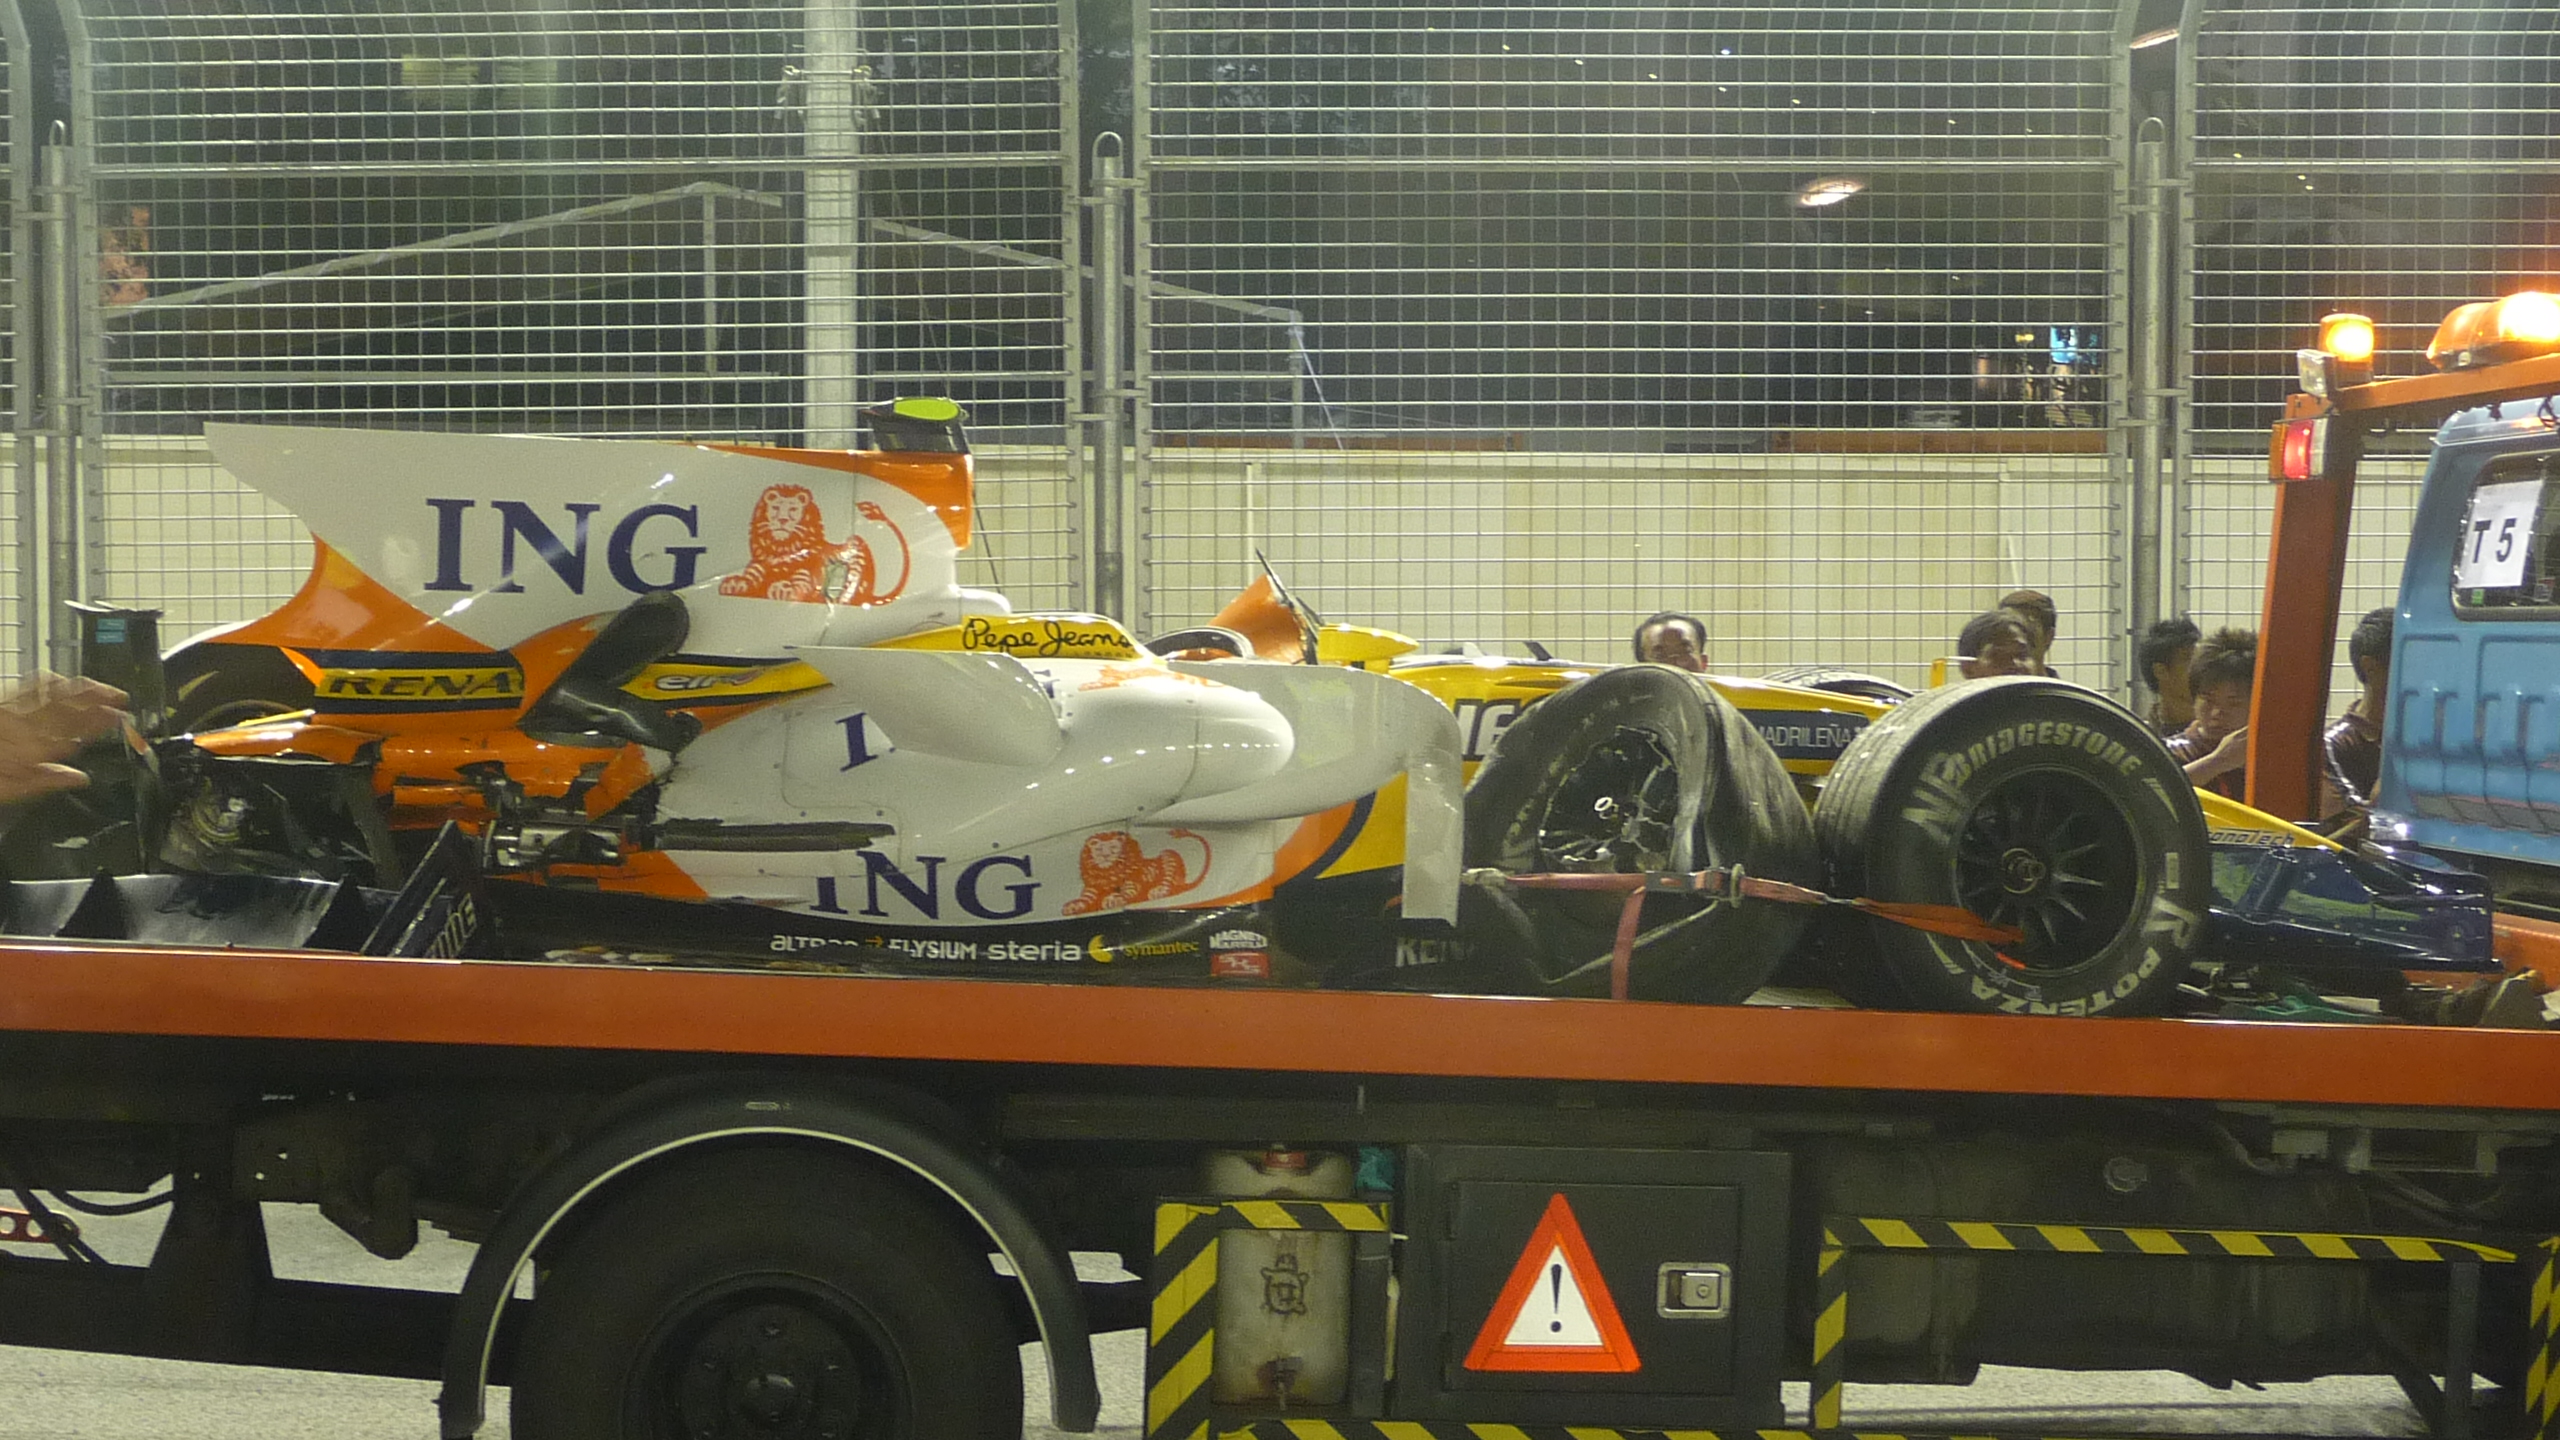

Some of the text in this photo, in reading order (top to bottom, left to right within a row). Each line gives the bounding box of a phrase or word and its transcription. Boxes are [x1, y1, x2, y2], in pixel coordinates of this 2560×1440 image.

[424, 497, 707, 595] ING
[962, 618, 1134, 657] Pepe Jeans
[328, 672, 524, 696] RENA
[1759, 722, 1852, 748] ADRILEÑA
[1943, 721, 2143, 790] BRIDGESTONE
[809, 850, 1042, 920] ING
[988, 940, 1081, 962] steria
[1124, 942, 1200, 960] symantec
[1971, 947, 2162, 1017] POTENZA
